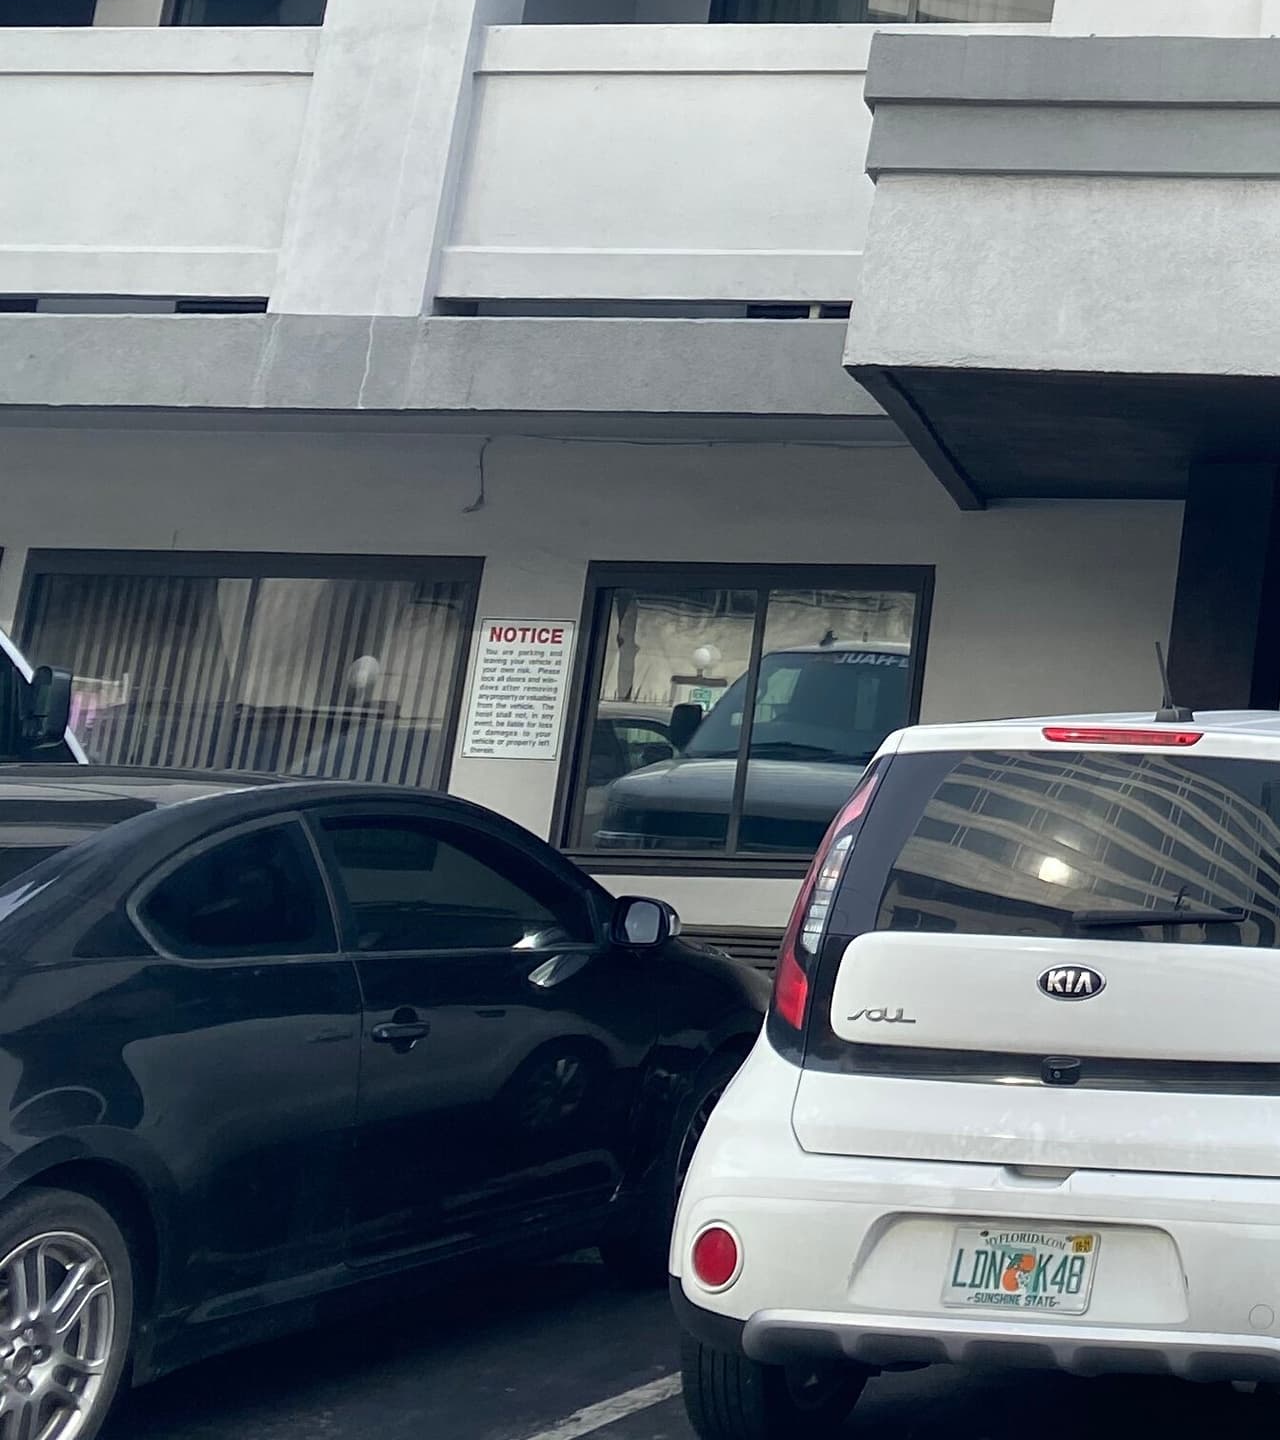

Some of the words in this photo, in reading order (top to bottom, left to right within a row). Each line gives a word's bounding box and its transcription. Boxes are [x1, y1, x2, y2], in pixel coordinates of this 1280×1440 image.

[489, 627, 564, 644] NOTICE
[1047, 970, 1093, 993] KIA
[952, 1248, 1006, 1290] LDN
[1032, 1253, 1086, 1294] K48
[974, 1292, 1021, 1306] SUNSHINE
[1024, 1294, 1057, 1308] STATE
